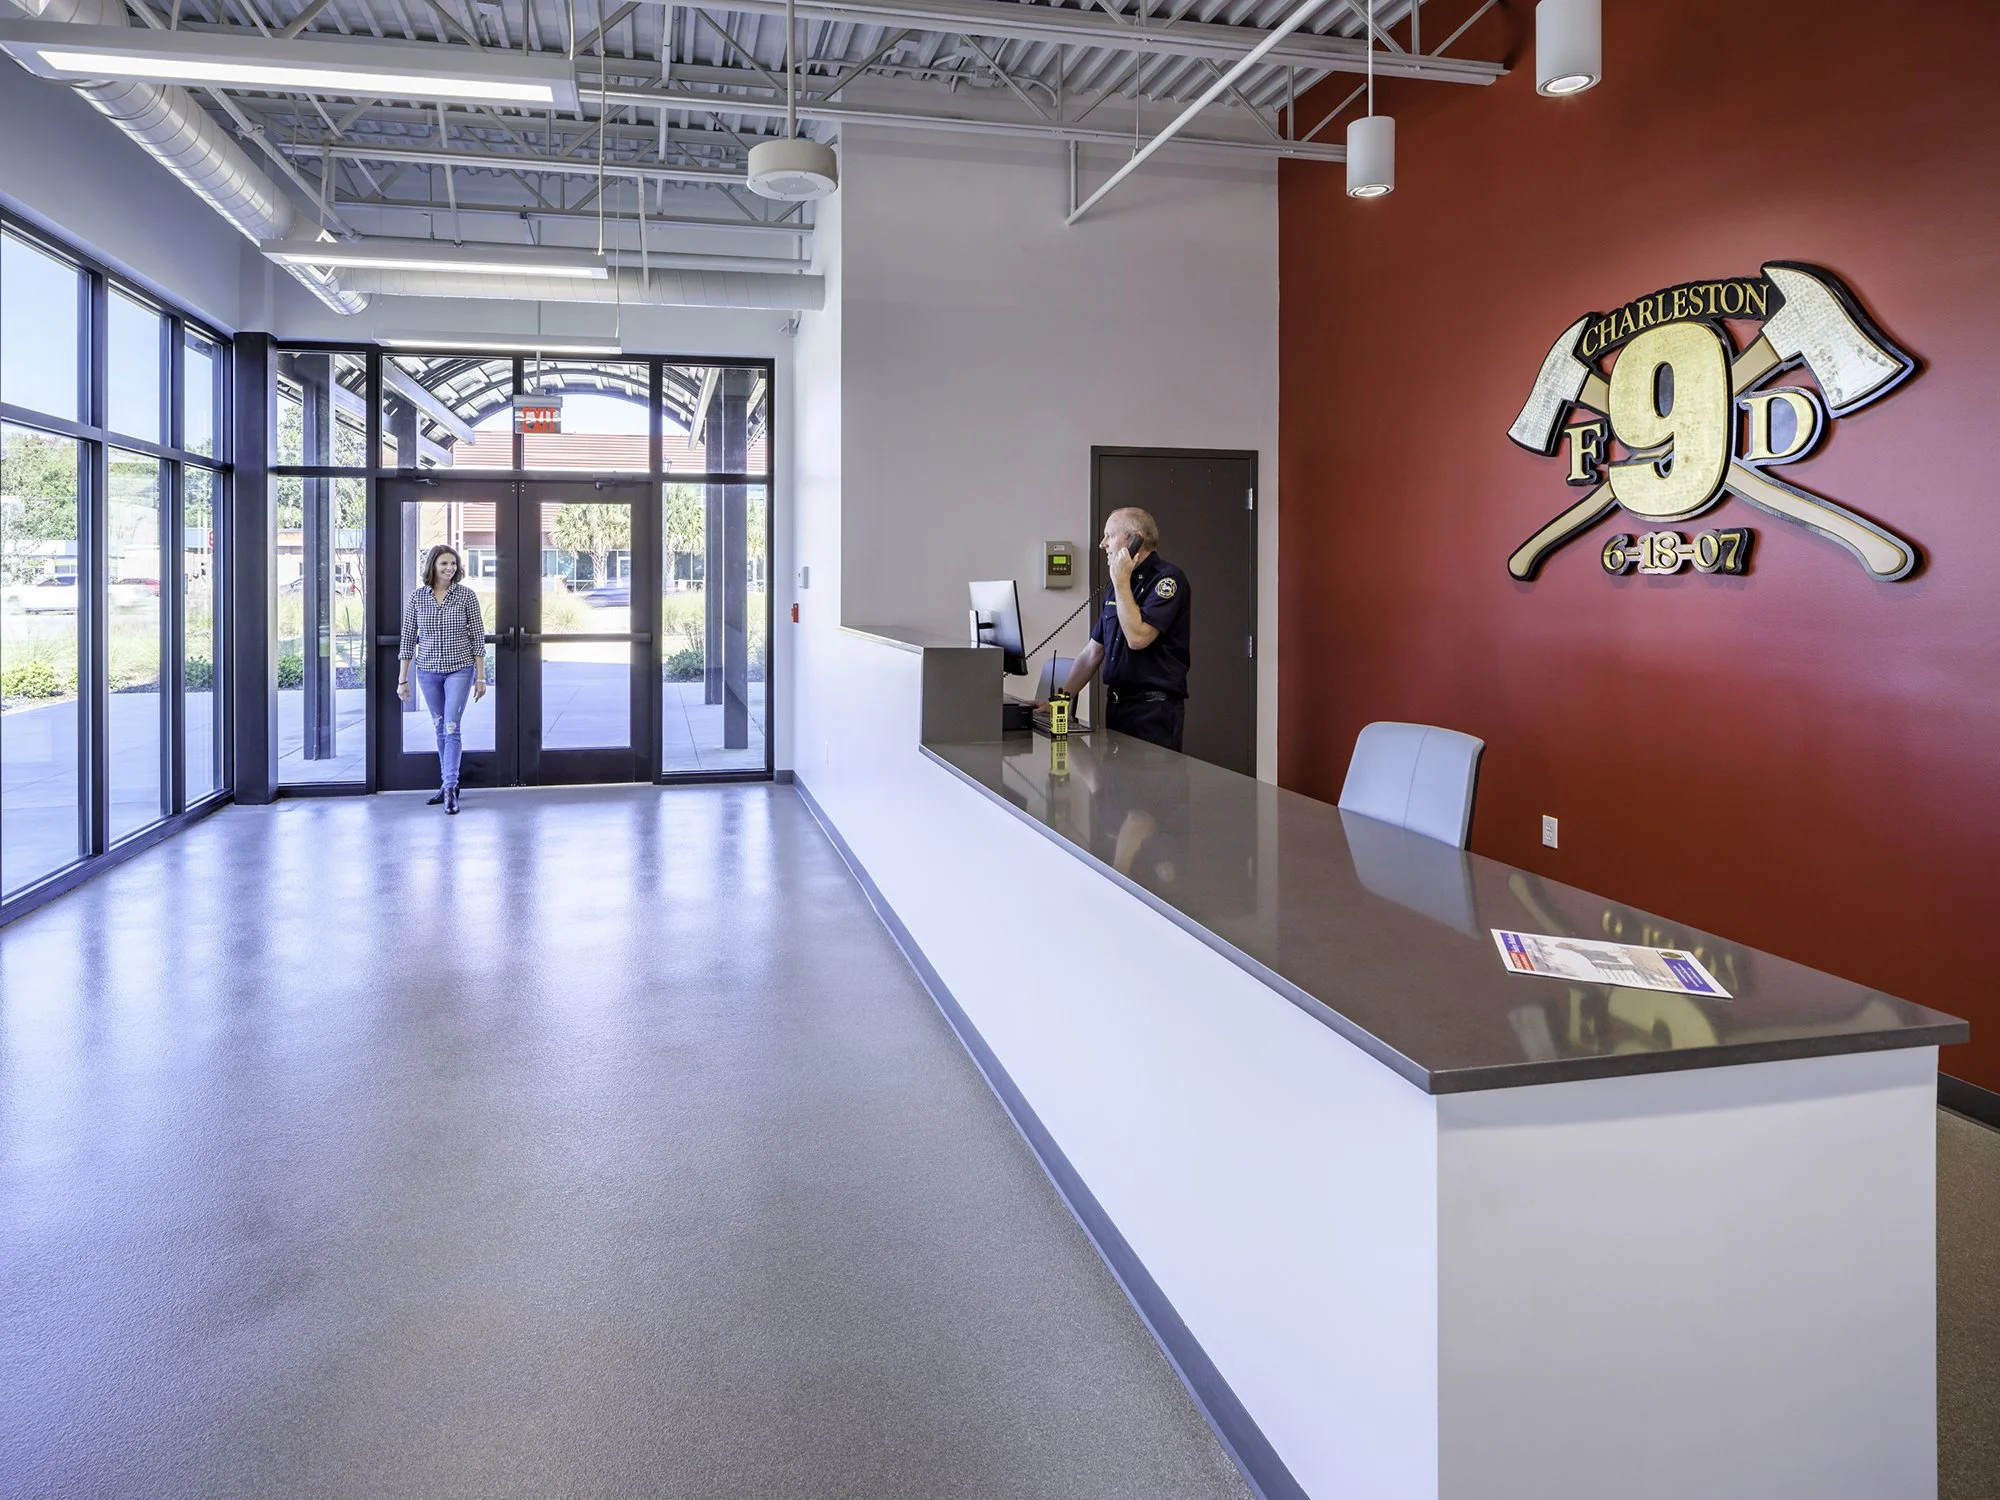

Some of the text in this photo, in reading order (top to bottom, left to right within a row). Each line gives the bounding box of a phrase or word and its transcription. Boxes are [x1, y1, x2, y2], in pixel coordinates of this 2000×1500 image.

[1582, 282, 1769, 356] CHARLESTON
[523, 407, 556, 432] EXIT
[1564, 321, 1814, 516] F 9 D
[1603, 532, 1743, 570] 6-18-07
